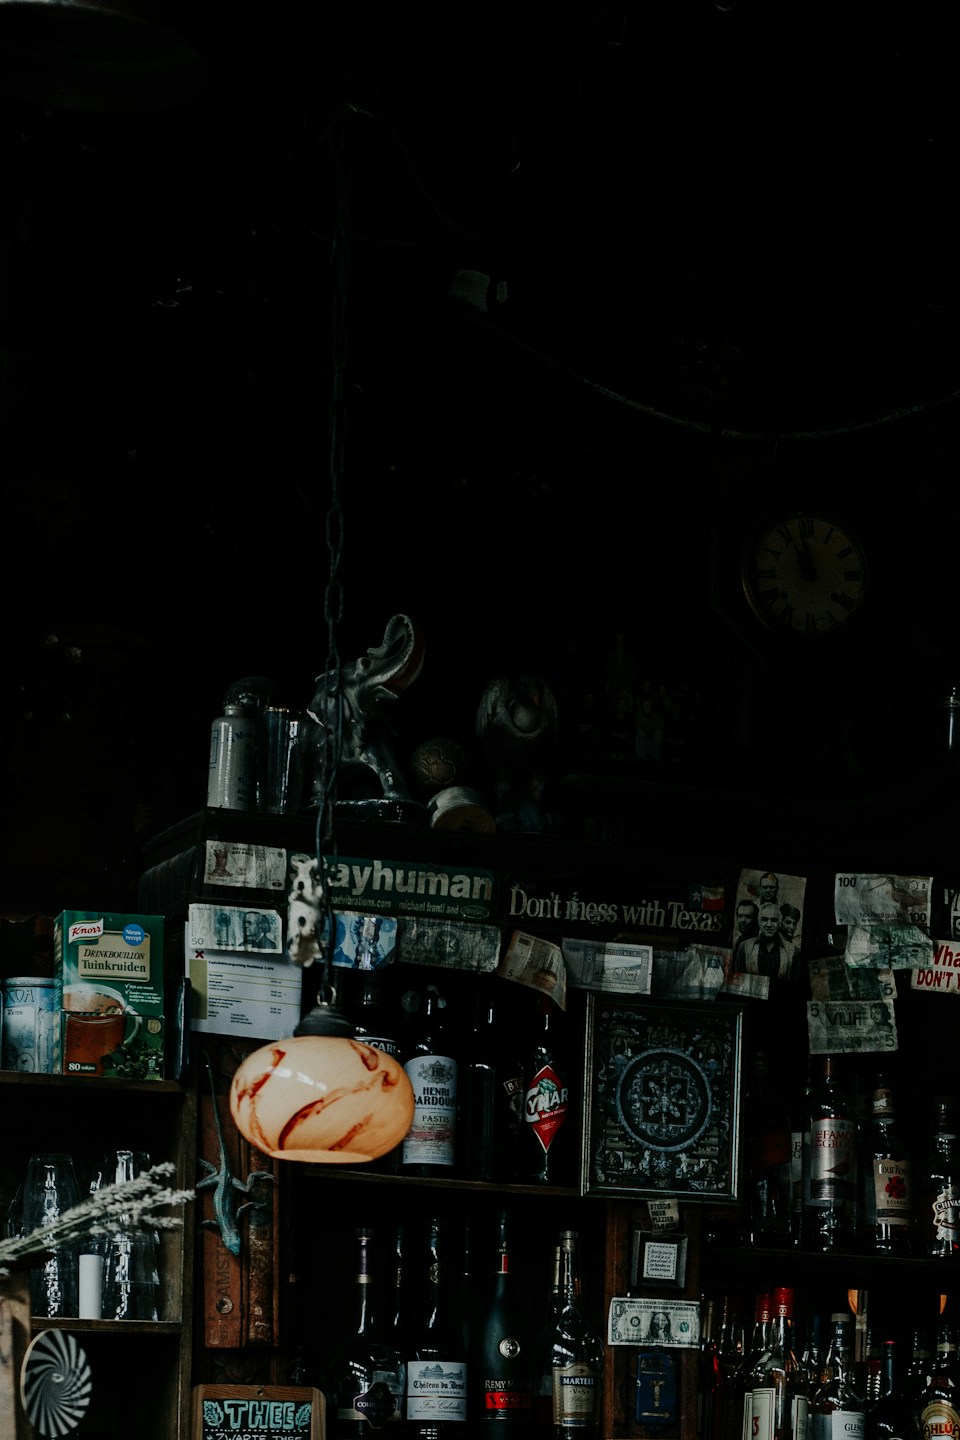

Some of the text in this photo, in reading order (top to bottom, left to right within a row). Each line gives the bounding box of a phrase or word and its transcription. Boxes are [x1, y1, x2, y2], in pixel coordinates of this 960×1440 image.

[838, 877, 857, 888] 100
[508, 886, 561, 917] Don't
[564, 898, 618, 925] mess
[622, 899, 666, 928] with
[667, 901, 723, 933] Texas
[909, 912, 927, 923] 100
[71, 925, 102, 937] Knorr
[191, 937, 204, 946] 50
[82, 959, 146, 973] Tuinkruiden
[917, 970, 953, 988] DON'T
[810, 1003, 819, 1017] 5
[68, 1062, 81, 1071] 80
[423, 1087, 450, 1096] HENRI
[526, 1087, 569, 1123] CYNAR
[562, 1376, 595, 1386] MARTELL
[223, 1400, 296, 1430] THEE
